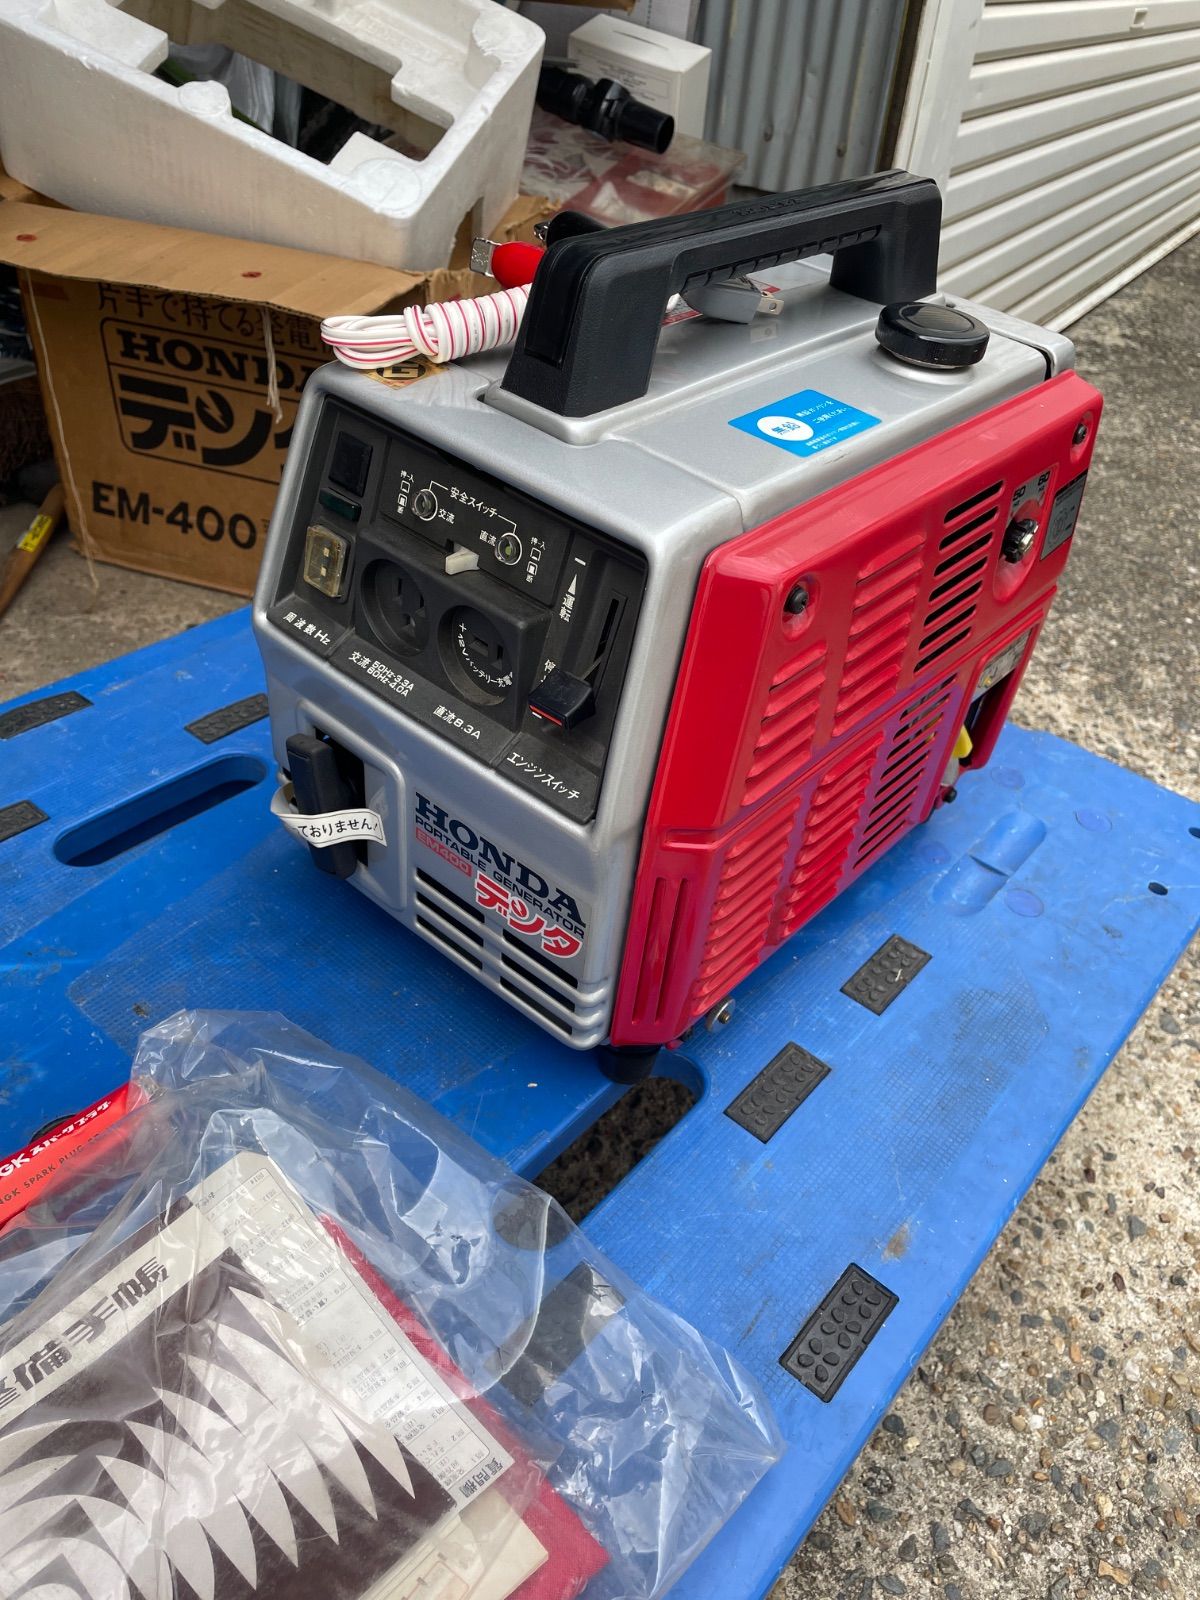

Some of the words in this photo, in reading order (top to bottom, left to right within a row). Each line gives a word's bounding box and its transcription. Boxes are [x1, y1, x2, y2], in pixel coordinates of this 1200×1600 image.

[98, 282, 329, 353] 片手で持てる発電
[92, 480, 257, 549] EM-400
[438, 508, 455, 524] 交流
[450, 486, 498, 518] 安全スイッチ
[479, 529, 498, 547] 直流
[559, 593, 576, 622] 運転
[348, 651, 371, 669] 交流
[506, 752, 580, 799] エンジンスイッチ
[415, 792, 586, 928] HONDA
[415, 814, 486, 872] PORTABLE
[493, 871, 585, 939] GENERATOR
[23, 1163, 56, 1188] SPARK
